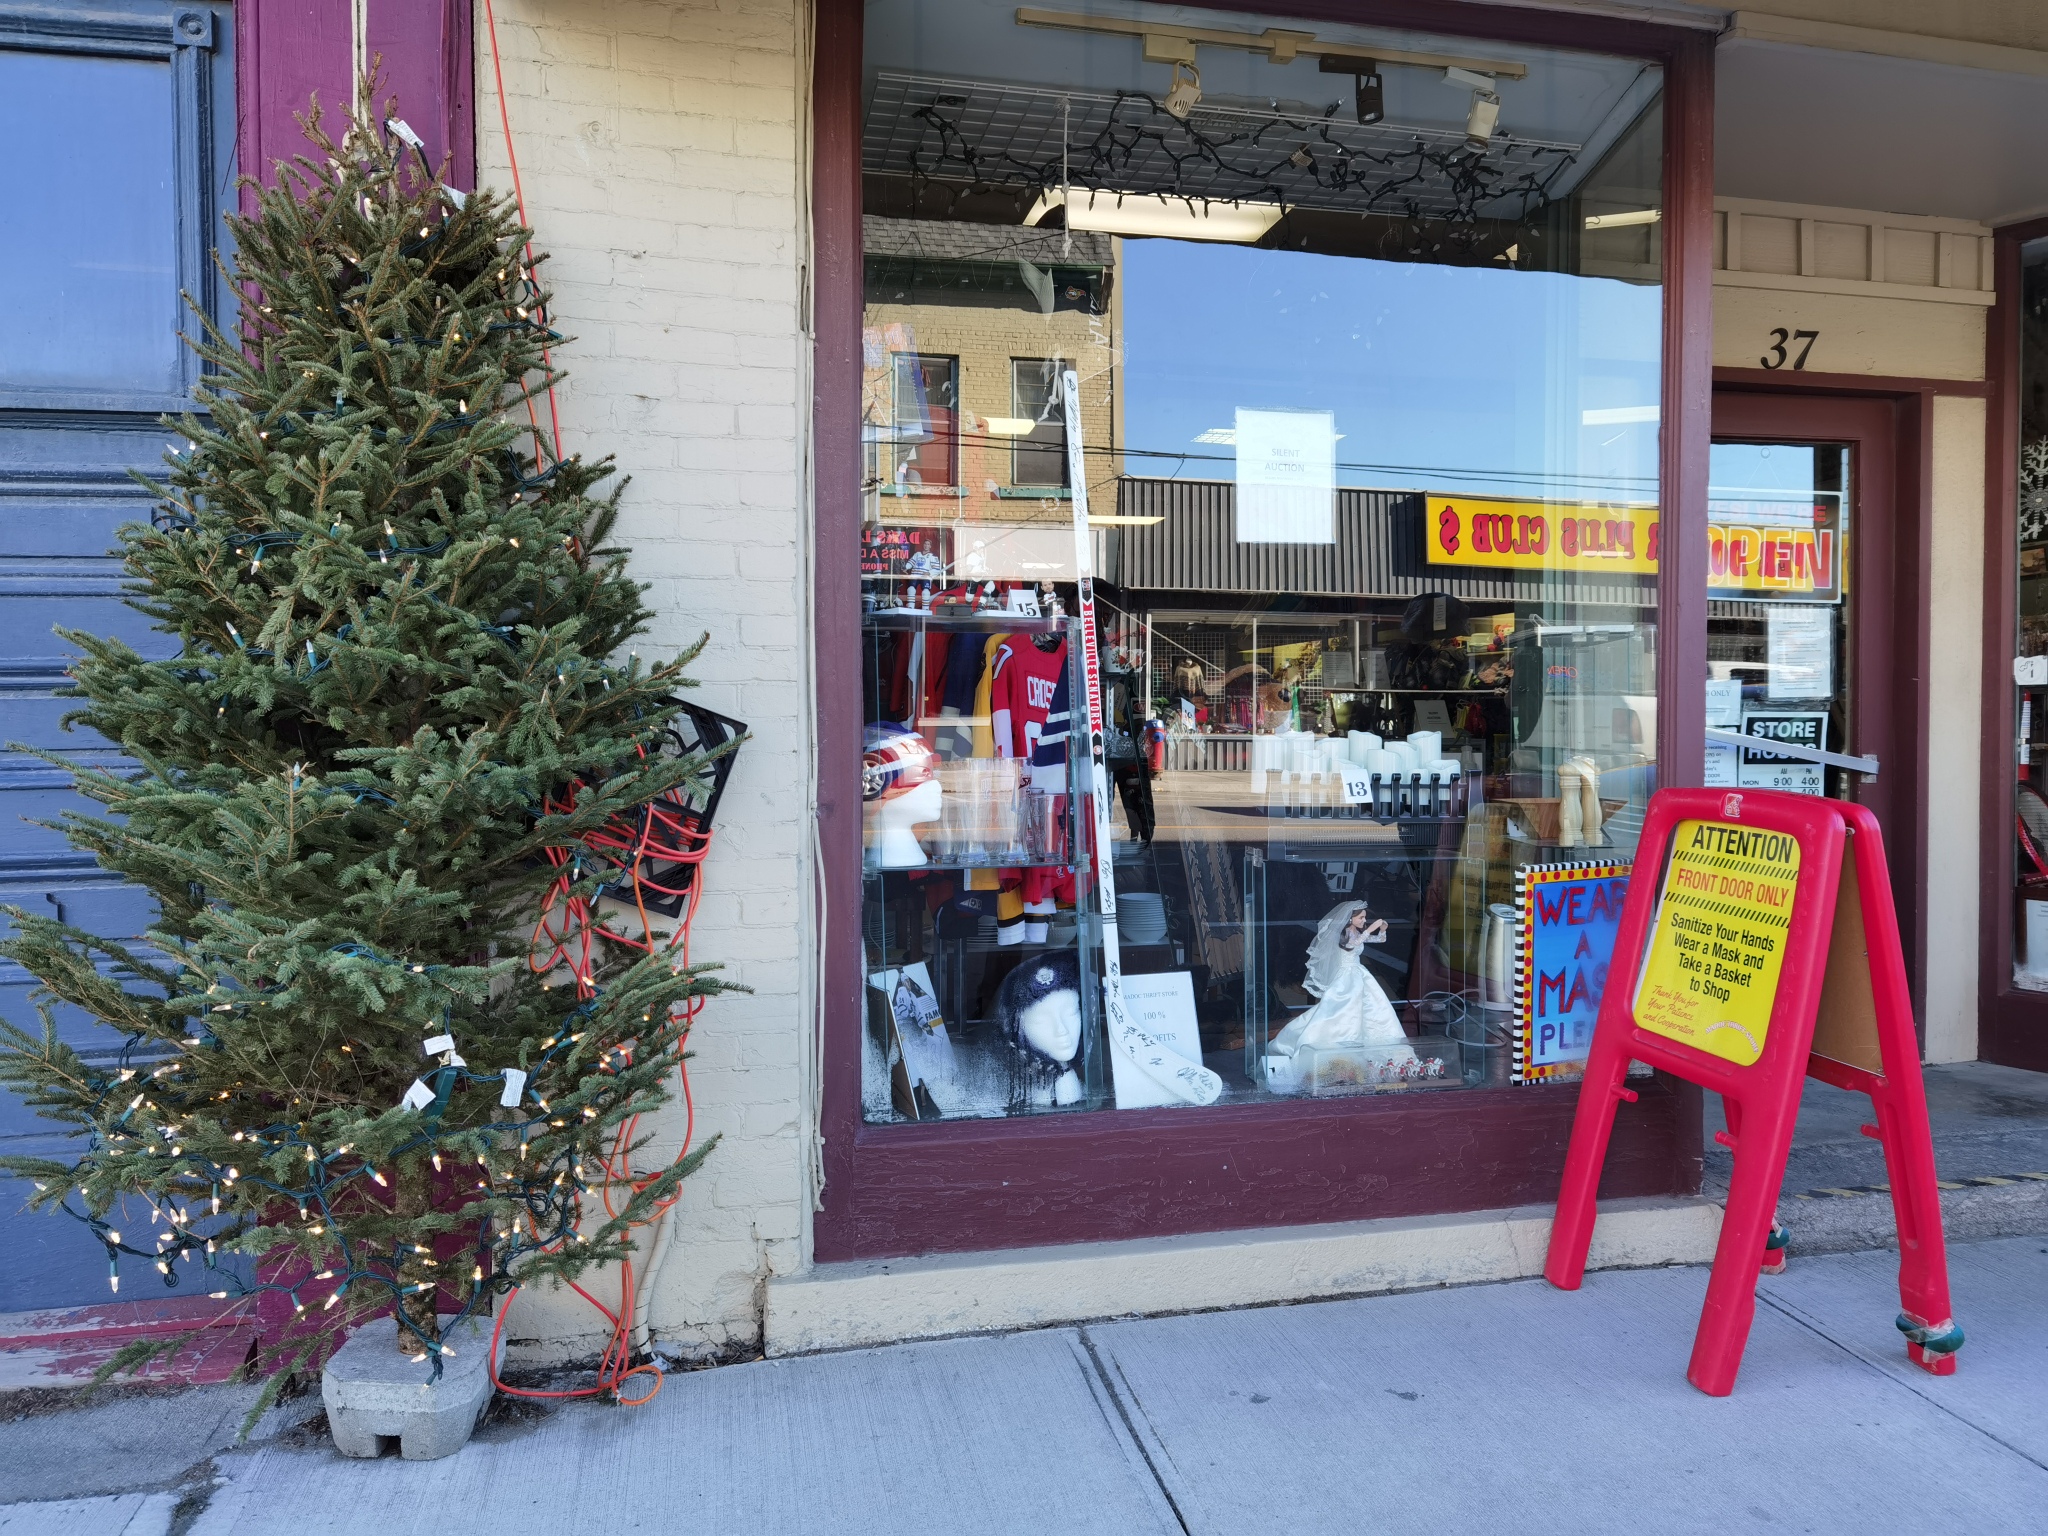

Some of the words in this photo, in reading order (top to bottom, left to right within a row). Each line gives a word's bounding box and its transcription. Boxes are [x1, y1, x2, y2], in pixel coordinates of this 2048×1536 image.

[1760, 327, 1820, 370] 37
[1264, 462, 1305, 472] AUCTION
[1271, 448, 1300, 458] SILENT
[1707, 524, 1833, 589] OPEN
[1016, 602, 1037, 616] 15
[1083, 610, 1098, 670] BELLEVILLE
[1027, 675, 1057, 710] CROS
[1088, 673, 1101, 725] SENATORS
[1752, 721, 1816, 738] STORE
[1345, 781, 1368, 798] 13
[1691, 825, 1795, 864] ATTENTION
[1536, 880, 1627, 927] WEAR
[1676, 868, 1718, 895] FRONT
[1719, 876, 1754, 901] DOOR
[1756, 884, 1790, 908] ONLY
[1574, 929, 1592, 960] A
[1670, 912, 1713, 936] Sanitize
[1715, 923, 1740, 942] Your
[1741, 929, 1775, 952] Hands
[1674, 932, 1700, 952] Wear
[1702, 942, 1709, 954] a
[1711, 942, 1740, 964] Mask
[1743, 952, 1765, 970] and
[1678, 952, 1701, 973] Take
[1704, 962, 1711, 975] a
[1714, 963, 1752, 988] Basket
[1538, 962, 1610, 1018] MAS
[1652, 985, 1673, 1000] Thank
[1672, 991, 1687, 1004] You
[1685, 996, 1699, 1009] for
[1690, 976, 1701, 992] to
[1702, 980, 1730, 1004] Shop
[925, 1009, 941, 1021] FAM
[1143, 1011, 1157, 1020] 100
[1643, 1012, 1657, 1023] and
[1657, 1015, 1695, 1036] Cooperation
[1647, 997, 1665, 1010] Your
[1667, 1003, 1694, 1021] Patience
[1152, 1033, 1177, 1041] OFITS
[1539, 1020, 1593, 1056] PLE
